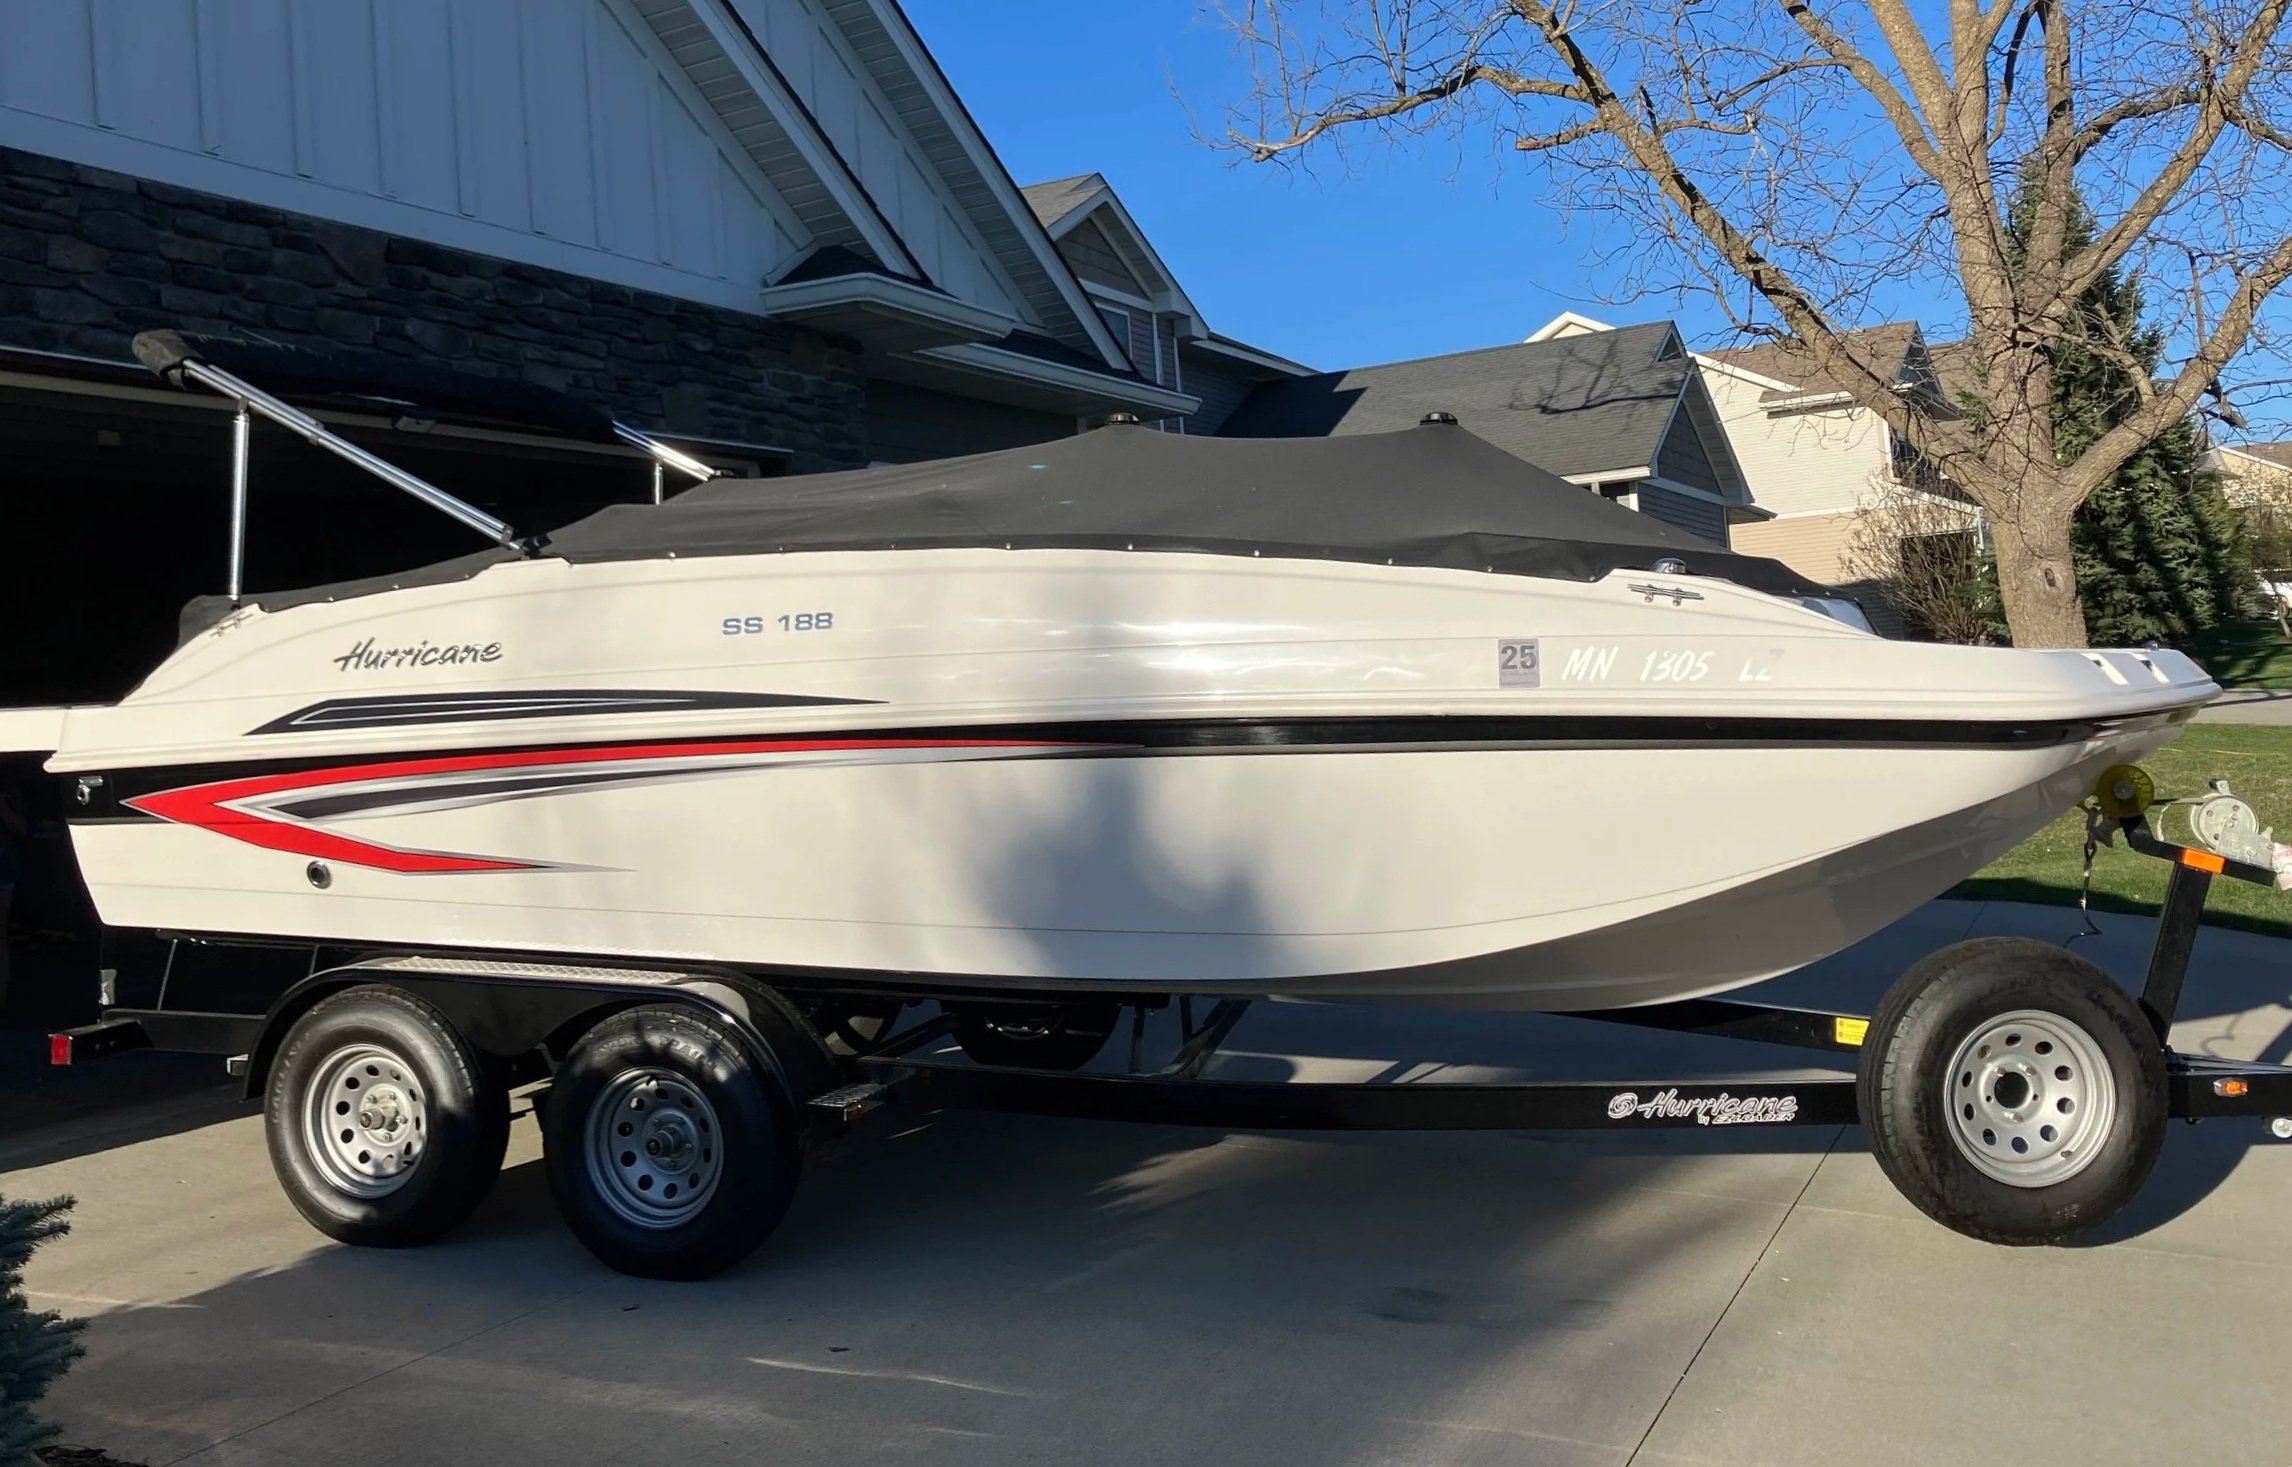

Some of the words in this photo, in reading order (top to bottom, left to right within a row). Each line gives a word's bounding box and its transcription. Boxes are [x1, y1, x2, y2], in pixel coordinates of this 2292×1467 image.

[722, 616, 763, 635] SS
[777, 612, 833, 632] 188
[333, 636, 503, 672] Hurricane
[1501, 645, 1537, 670] 25
[1561, 646, 1619, 681] MN
[1640, 650, 1715, 682] 1305
[1637, 1088, 1798, 1119] Hurricane
